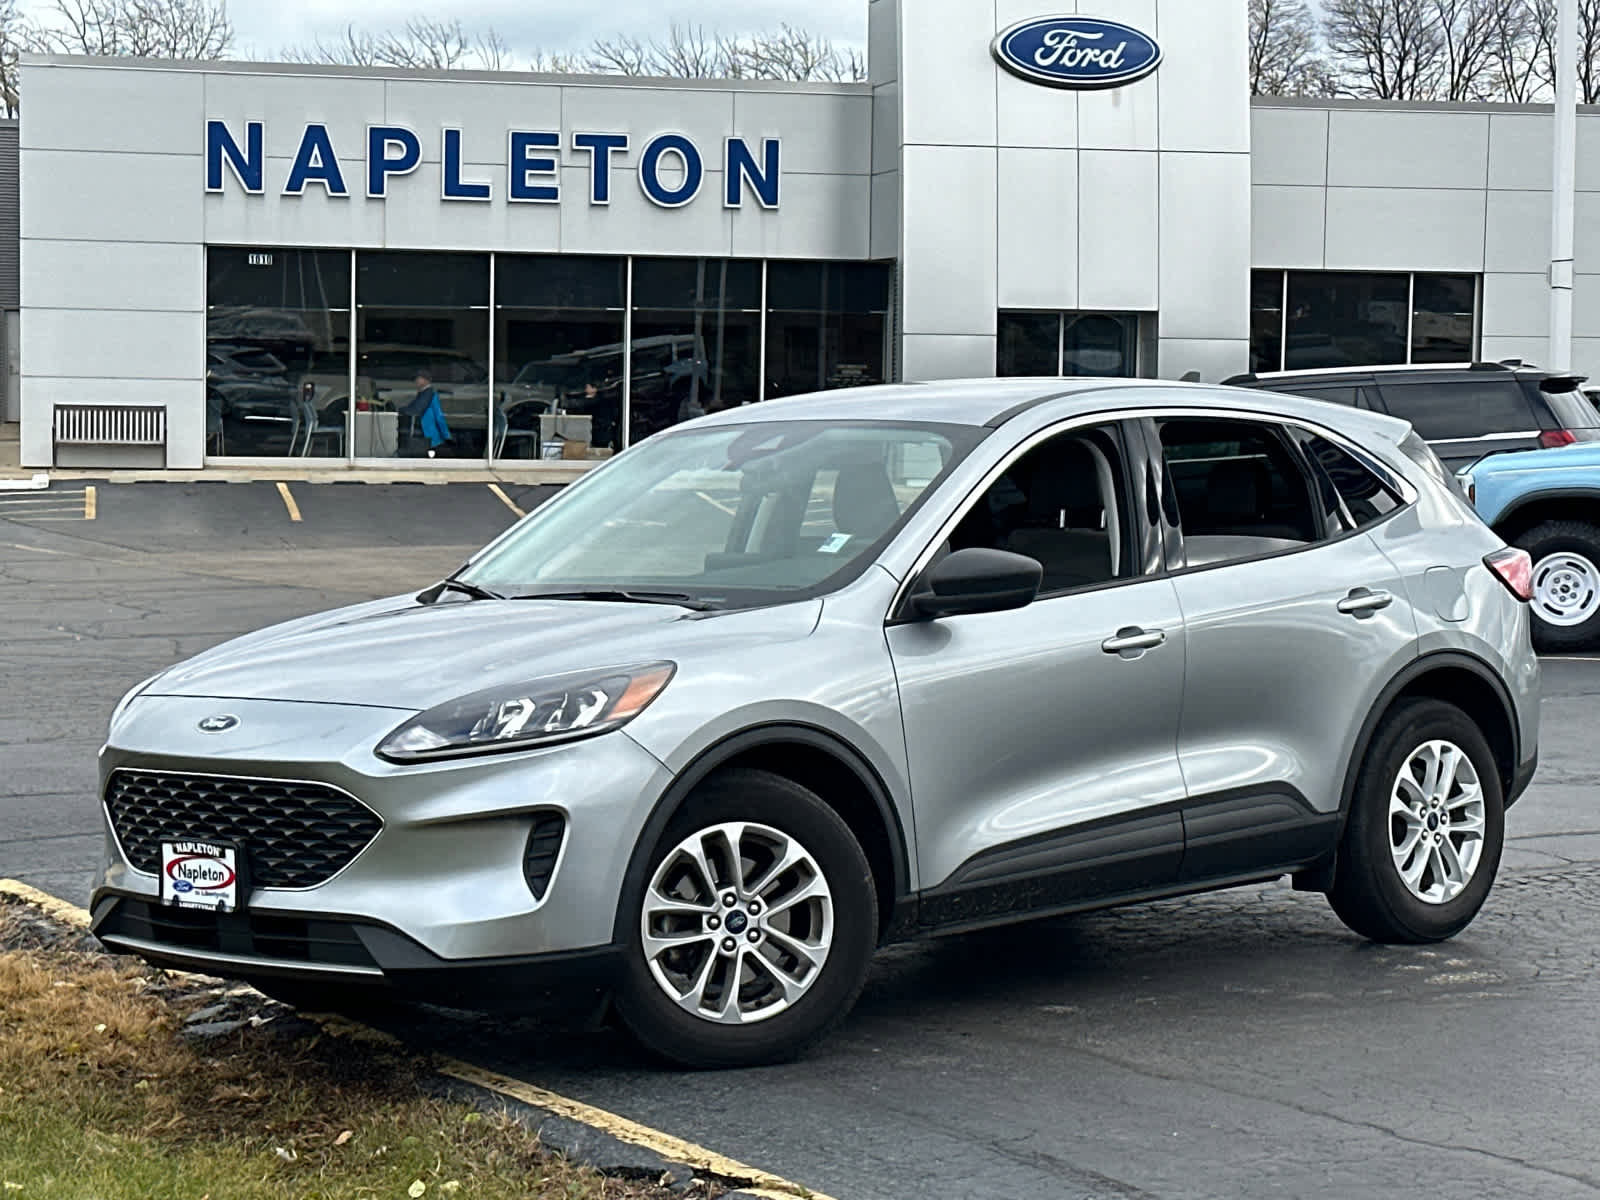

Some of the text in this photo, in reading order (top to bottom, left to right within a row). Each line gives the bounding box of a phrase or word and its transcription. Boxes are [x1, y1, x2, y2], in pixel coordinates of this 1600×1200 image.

[1034, 29, 1127, 69] Ford
[204, 119, 781, 210] NAPLETON
[175, 842, 220, 857] NAPLETON
[177, 861, 225, 883] Napleton
